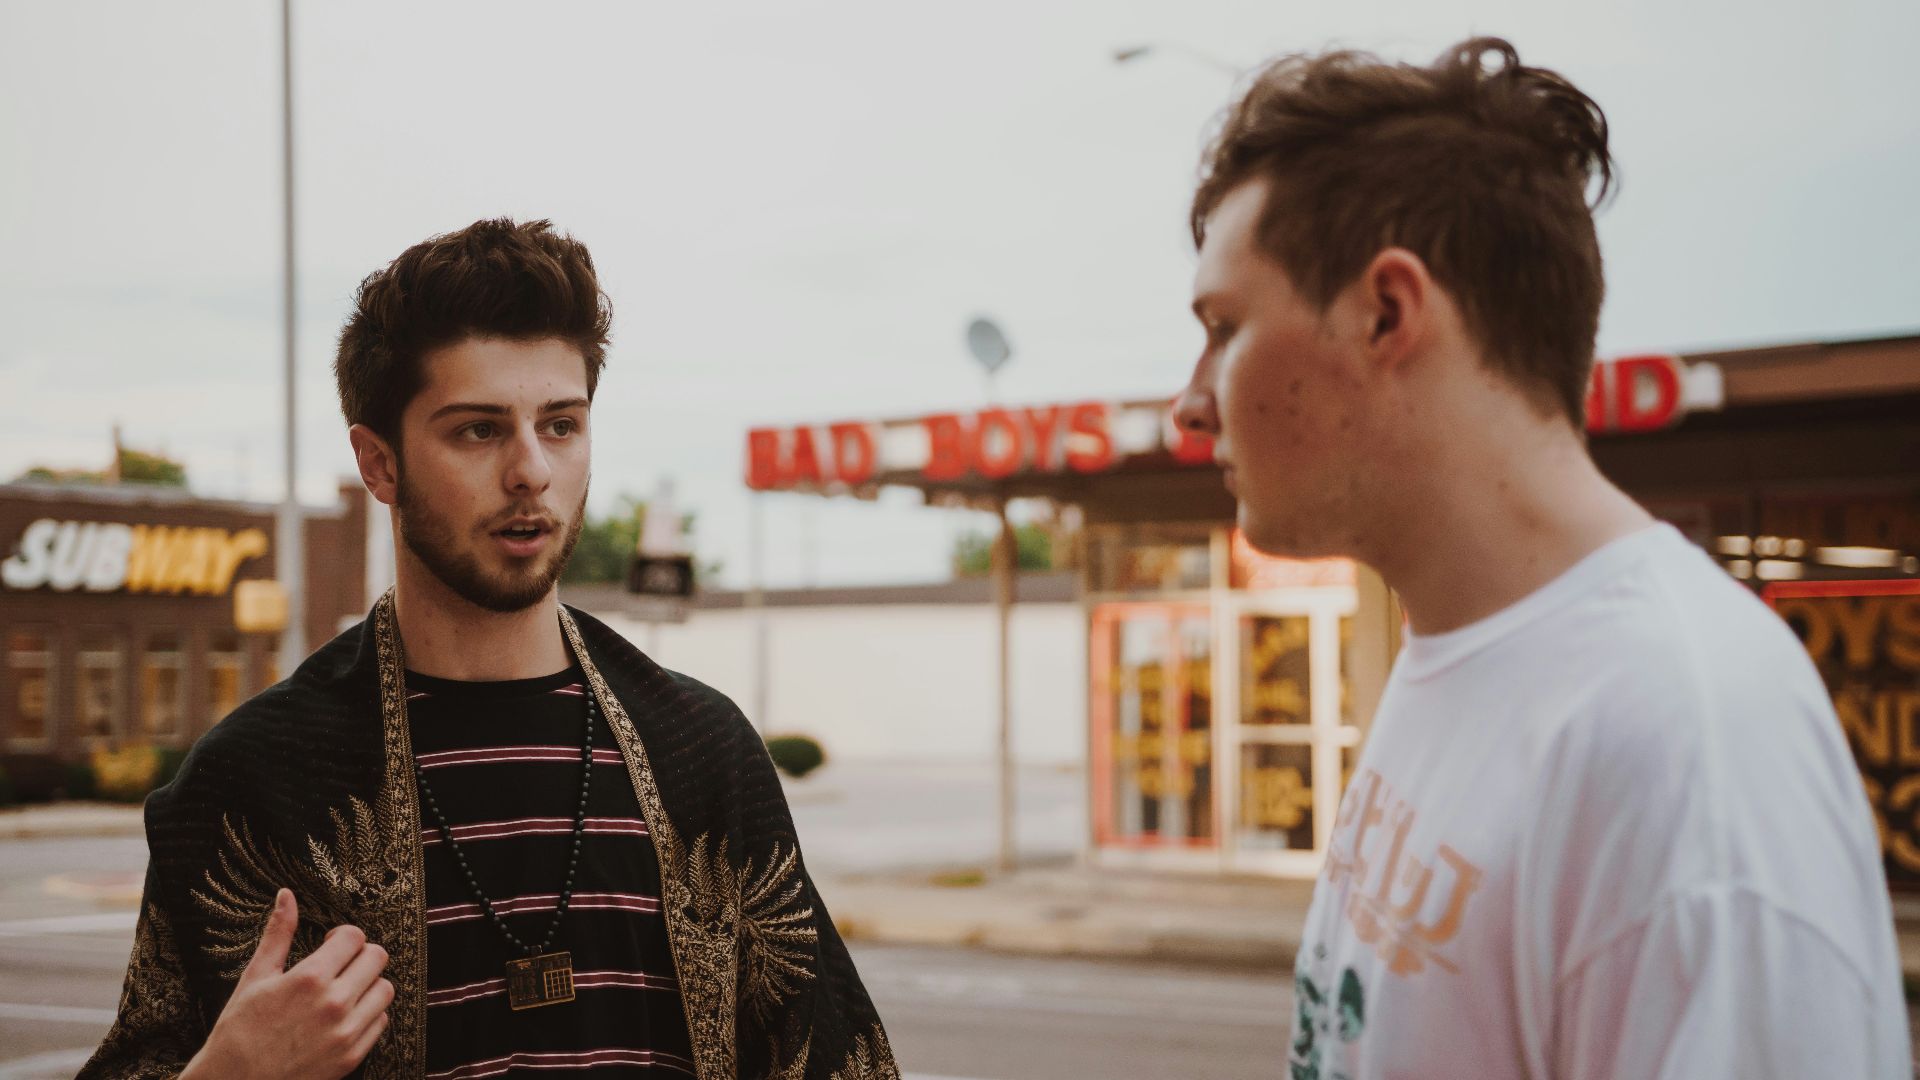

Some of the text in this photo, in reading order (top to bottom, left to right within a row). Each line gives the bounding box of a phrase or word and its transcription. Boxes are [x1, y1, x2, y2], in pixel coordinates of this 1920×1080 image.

[746, 420, 876, 489] BAD
[922, 402, 1116, 480] BOYS
[1, 519, 268, 595] SUBWAY
